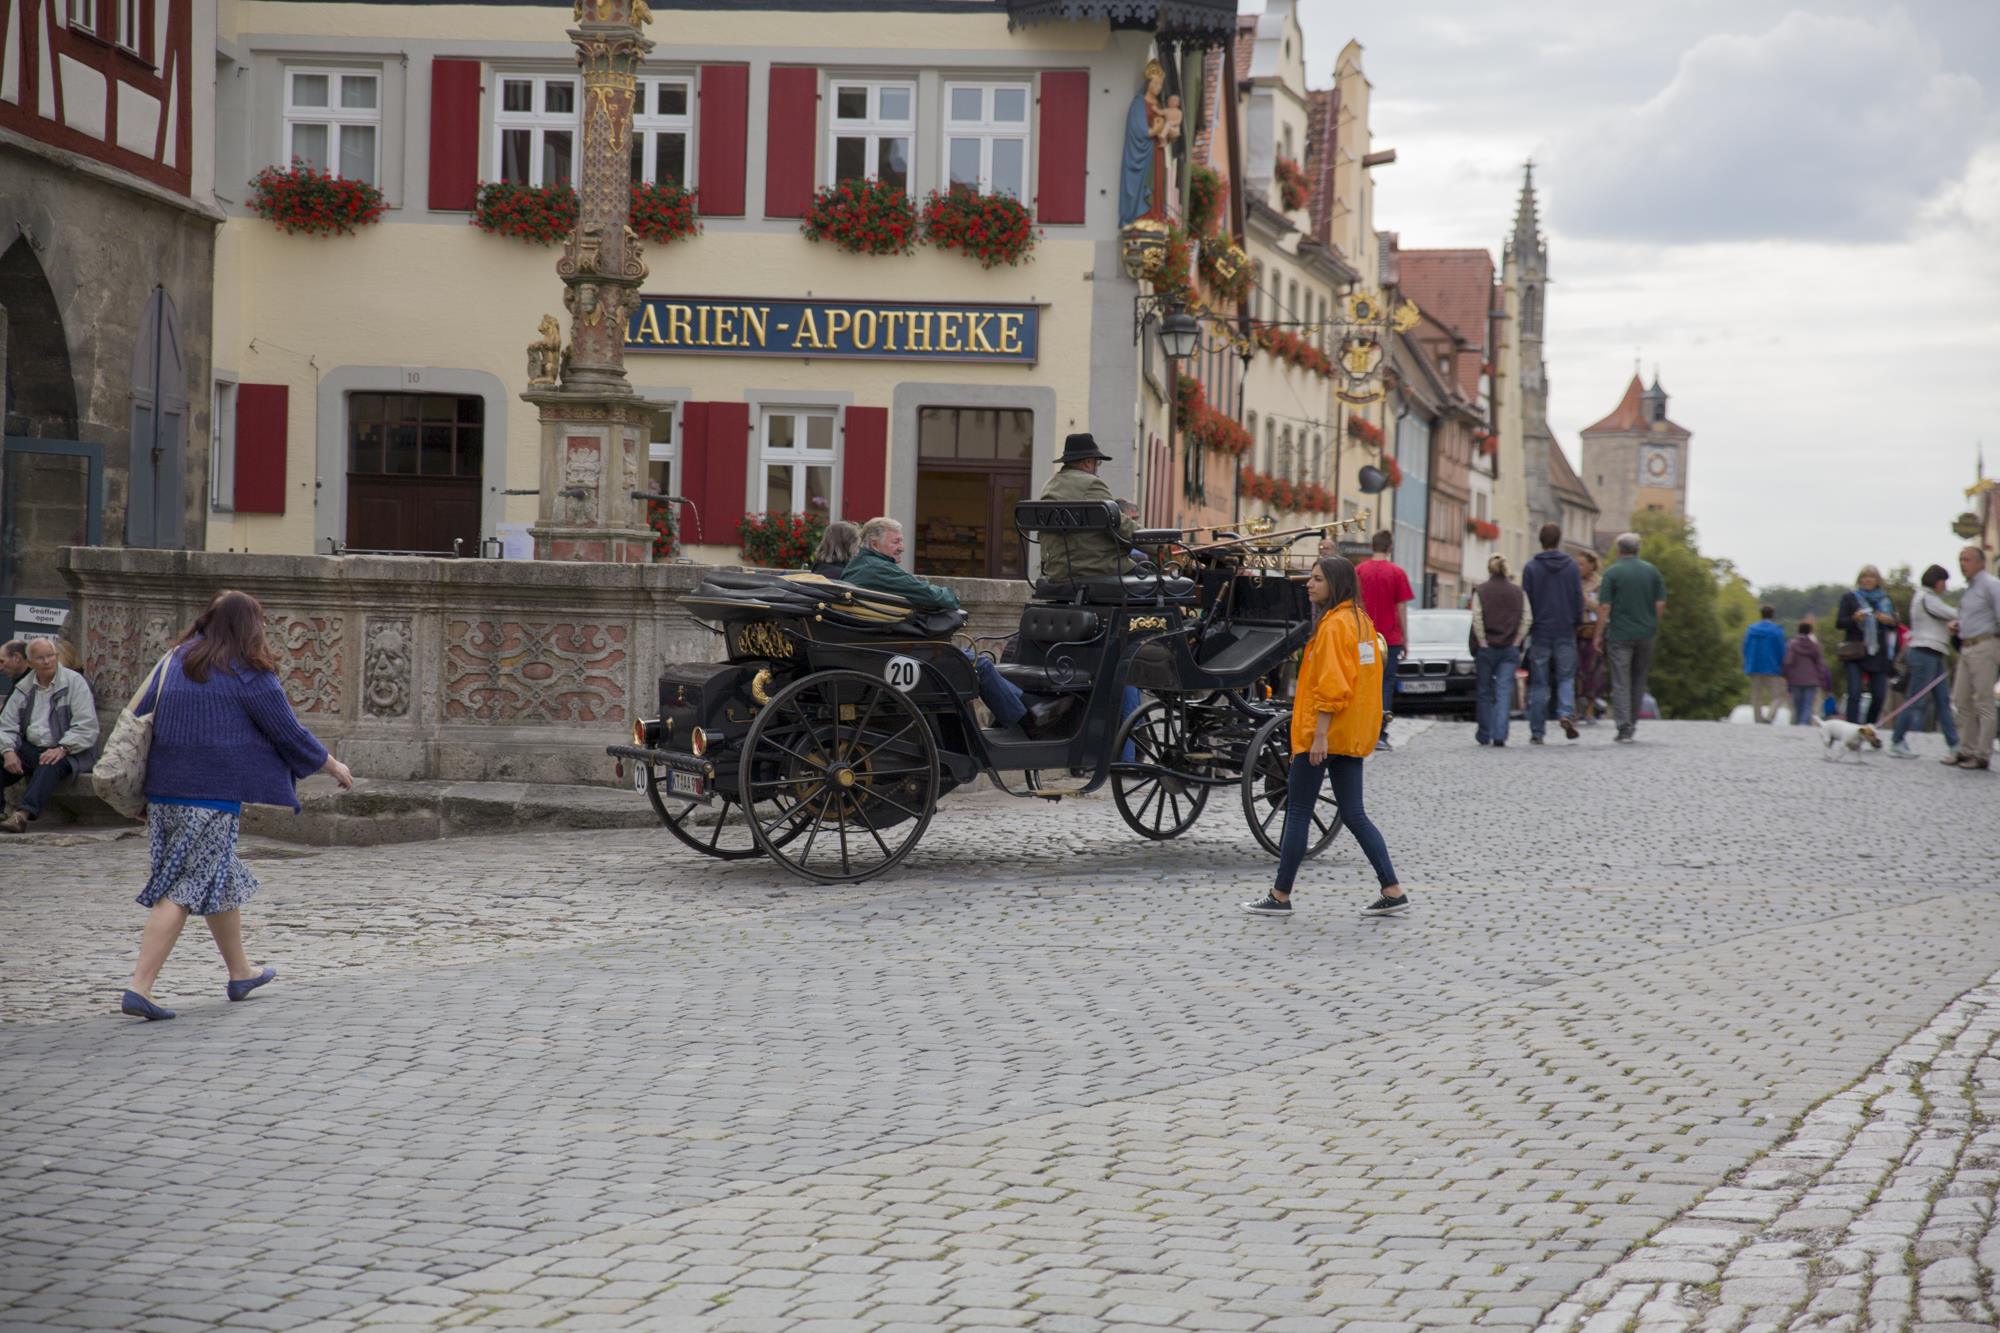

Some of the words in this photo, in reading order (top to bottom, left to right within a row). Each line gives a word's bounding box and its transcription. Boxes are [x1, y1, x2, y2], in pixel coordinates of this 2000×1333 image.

[623, 303, 1025, 354] ARIEN-APOTHEKE
[407, 372, 420, 384] 10
[29, 607, 61, 616] Geöffnet
[891, 662, 914, 686] 20
[636, 765, 646, 789] 20
